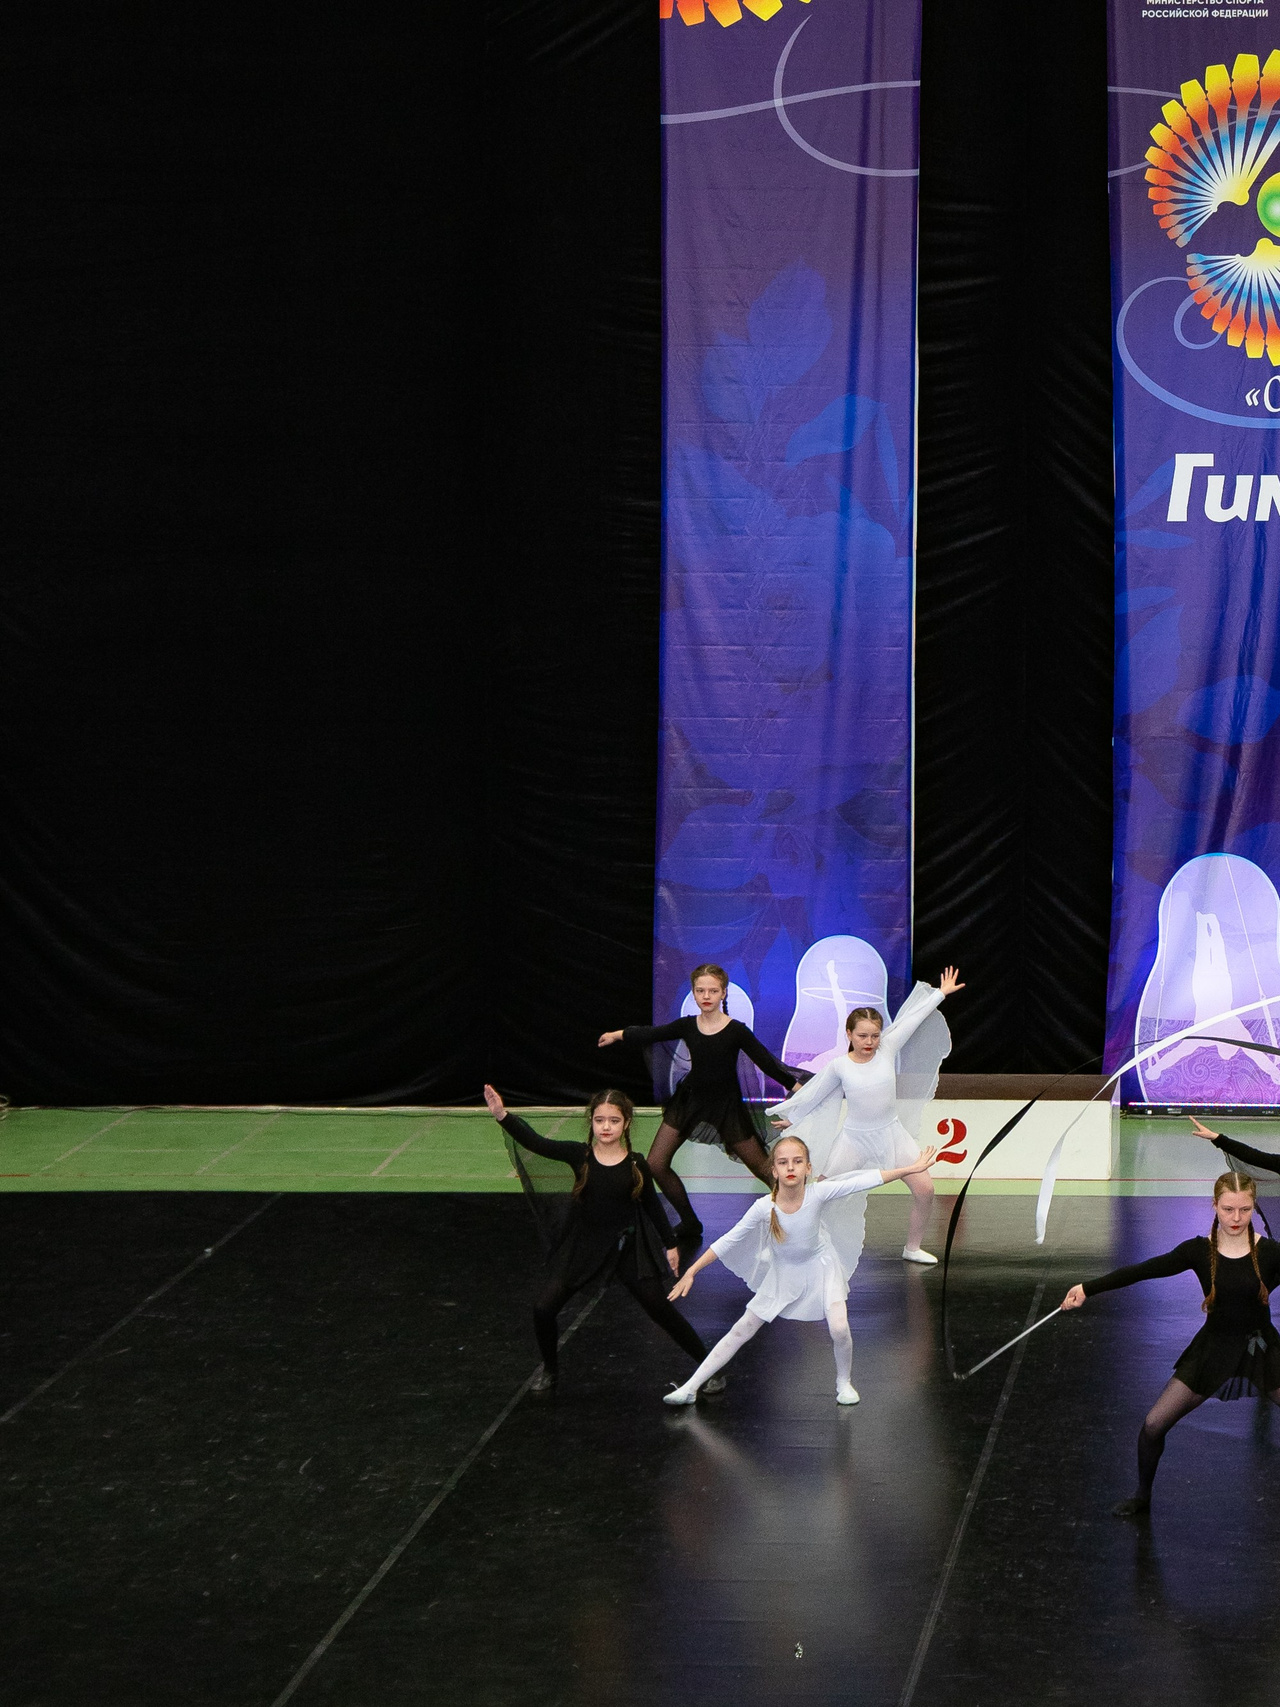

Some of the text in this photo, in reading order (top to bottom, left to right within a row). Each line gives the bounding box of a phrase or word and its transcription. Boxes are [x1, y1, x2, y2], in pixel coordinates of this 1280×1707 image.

[1141, 8, 1269, 19] РОССИЙСКОЙ ФЕДЕРАЦИИ
[935, 1118, 968, 1164] 2
